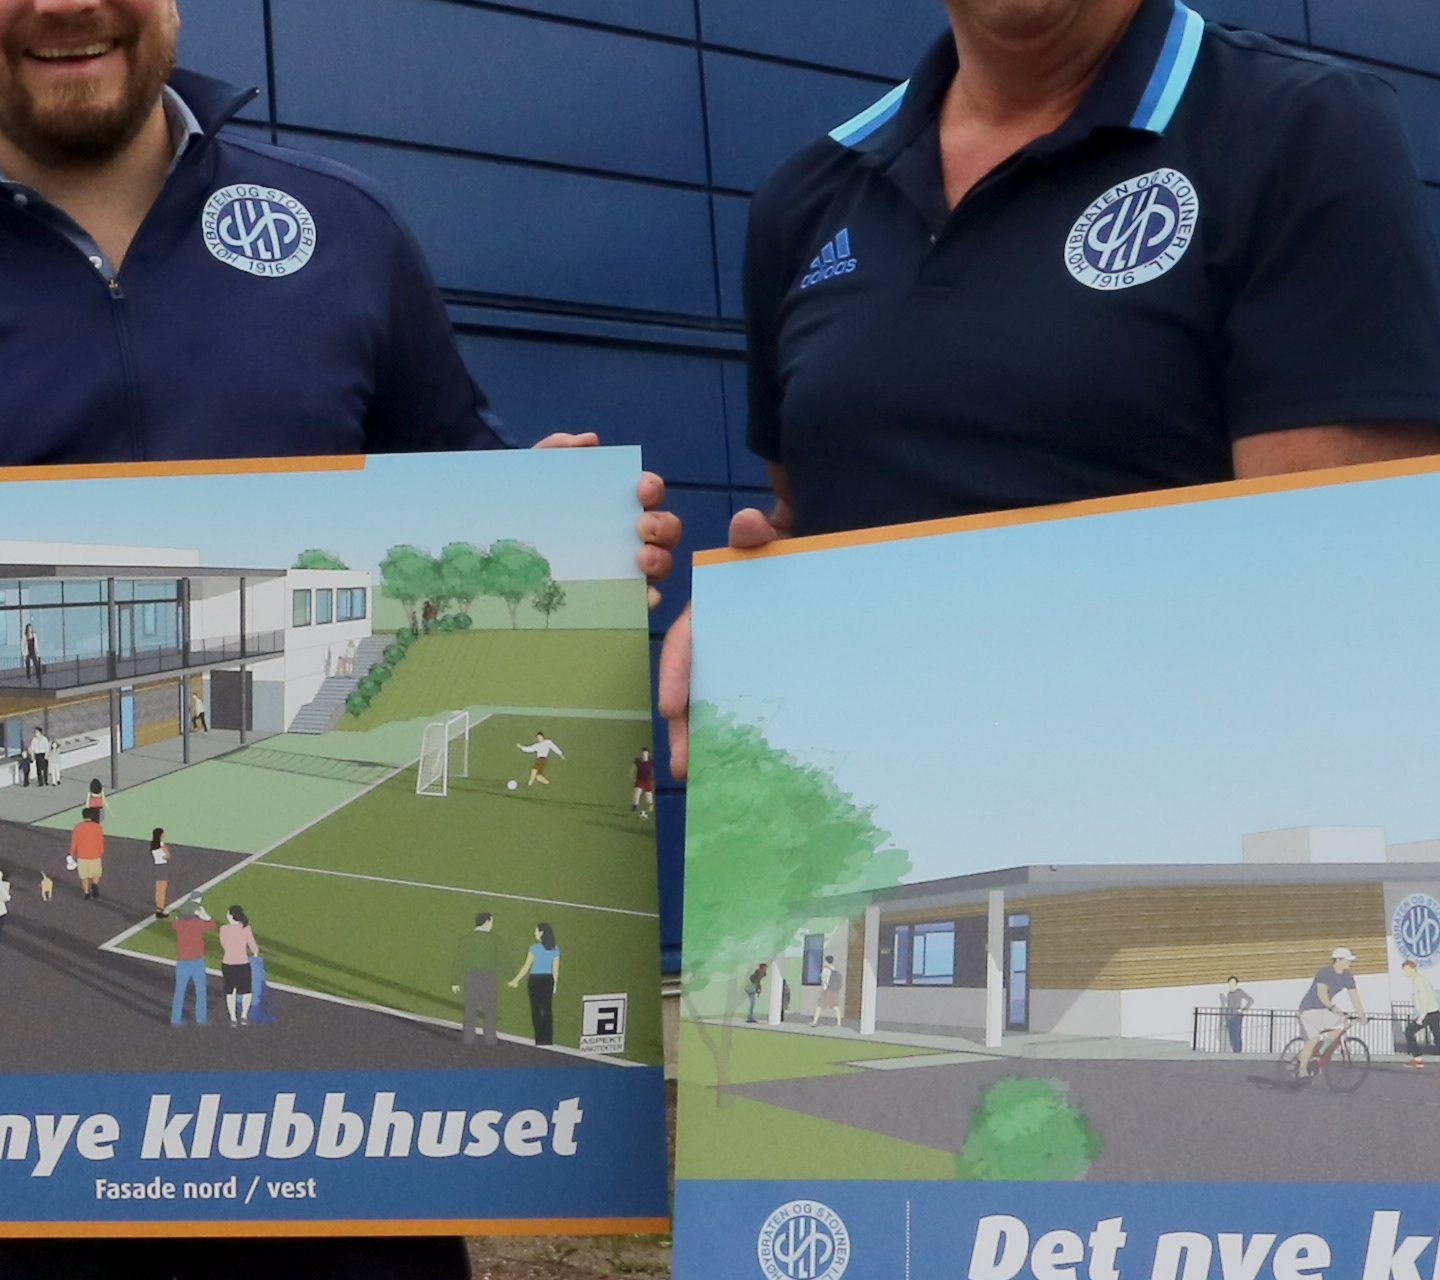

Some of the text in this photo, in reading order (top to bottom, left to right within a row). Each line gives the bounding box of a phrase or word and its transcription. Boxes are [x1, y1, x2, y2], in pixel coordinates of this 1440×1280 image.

[236, 186, 259, 197] OG
[266, 190, 313, 247] STOVNER
[1162, 172, 1195, 249] STOVNER
[249, 261, 286, 274] 1916
[1092, 272, 1135, 287] 1916
[582, 1036, 623, 1045] ASPEKT
[141, 1092, 582, 1159] klubbhuset
[96, 1176, 316, 1204] Fasade nord / vest
[793, 1204, 812, 1214] OG
[816, 1207, 847, 1265] STOVNER
